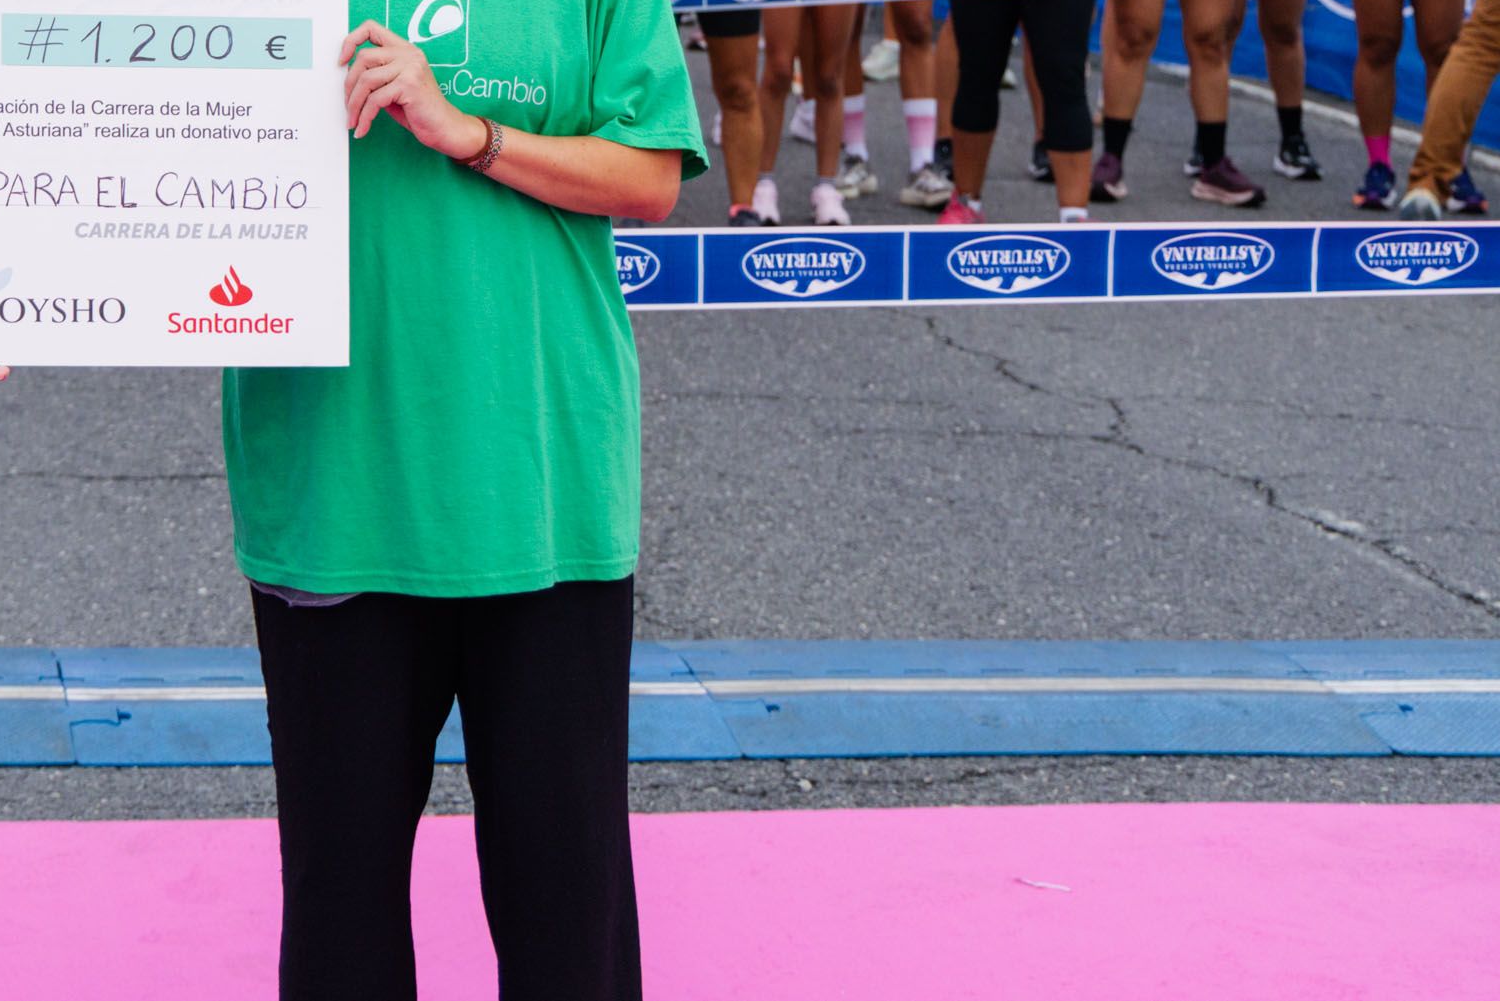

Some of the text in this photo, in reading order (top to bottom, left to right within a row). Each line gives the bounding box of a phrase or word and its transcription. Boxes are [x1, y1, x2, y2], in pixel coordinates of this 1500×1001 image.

[264, 35, 287, 61] €
[44, 99, 65, 114] de
[71, 99, 88, 114] la
[92, 100, 154, 115] Carrera
[160, 102, 180, 115] de
[187, 102, 199, 115] la
[207, 102, 252, 120] Mujer
[3, 123, 88, 137] Asturiana”
[95, 124, 149, 137] realiza
[156, 128, 175, 138] un
[181, 124, 251, 140] donativo
[258, 129, 297, 142] para:
[97, 177, 137, 208] EL
[156, 172, 306, 210] CAMBIO
[75, 223, 308, 239] CARRERA DE LA MUJER
[752, 251, 856, 275] ASTURIANA
[958, 248, 1060, 271] ASTURIANA
[1162, 244, 1266, 268] ASTURIANA
[1366, 240, 1470, 264] ASTURIANA
[0, 298, 125, 323] OYSHO
[168, 313, 293, 333] Santander
